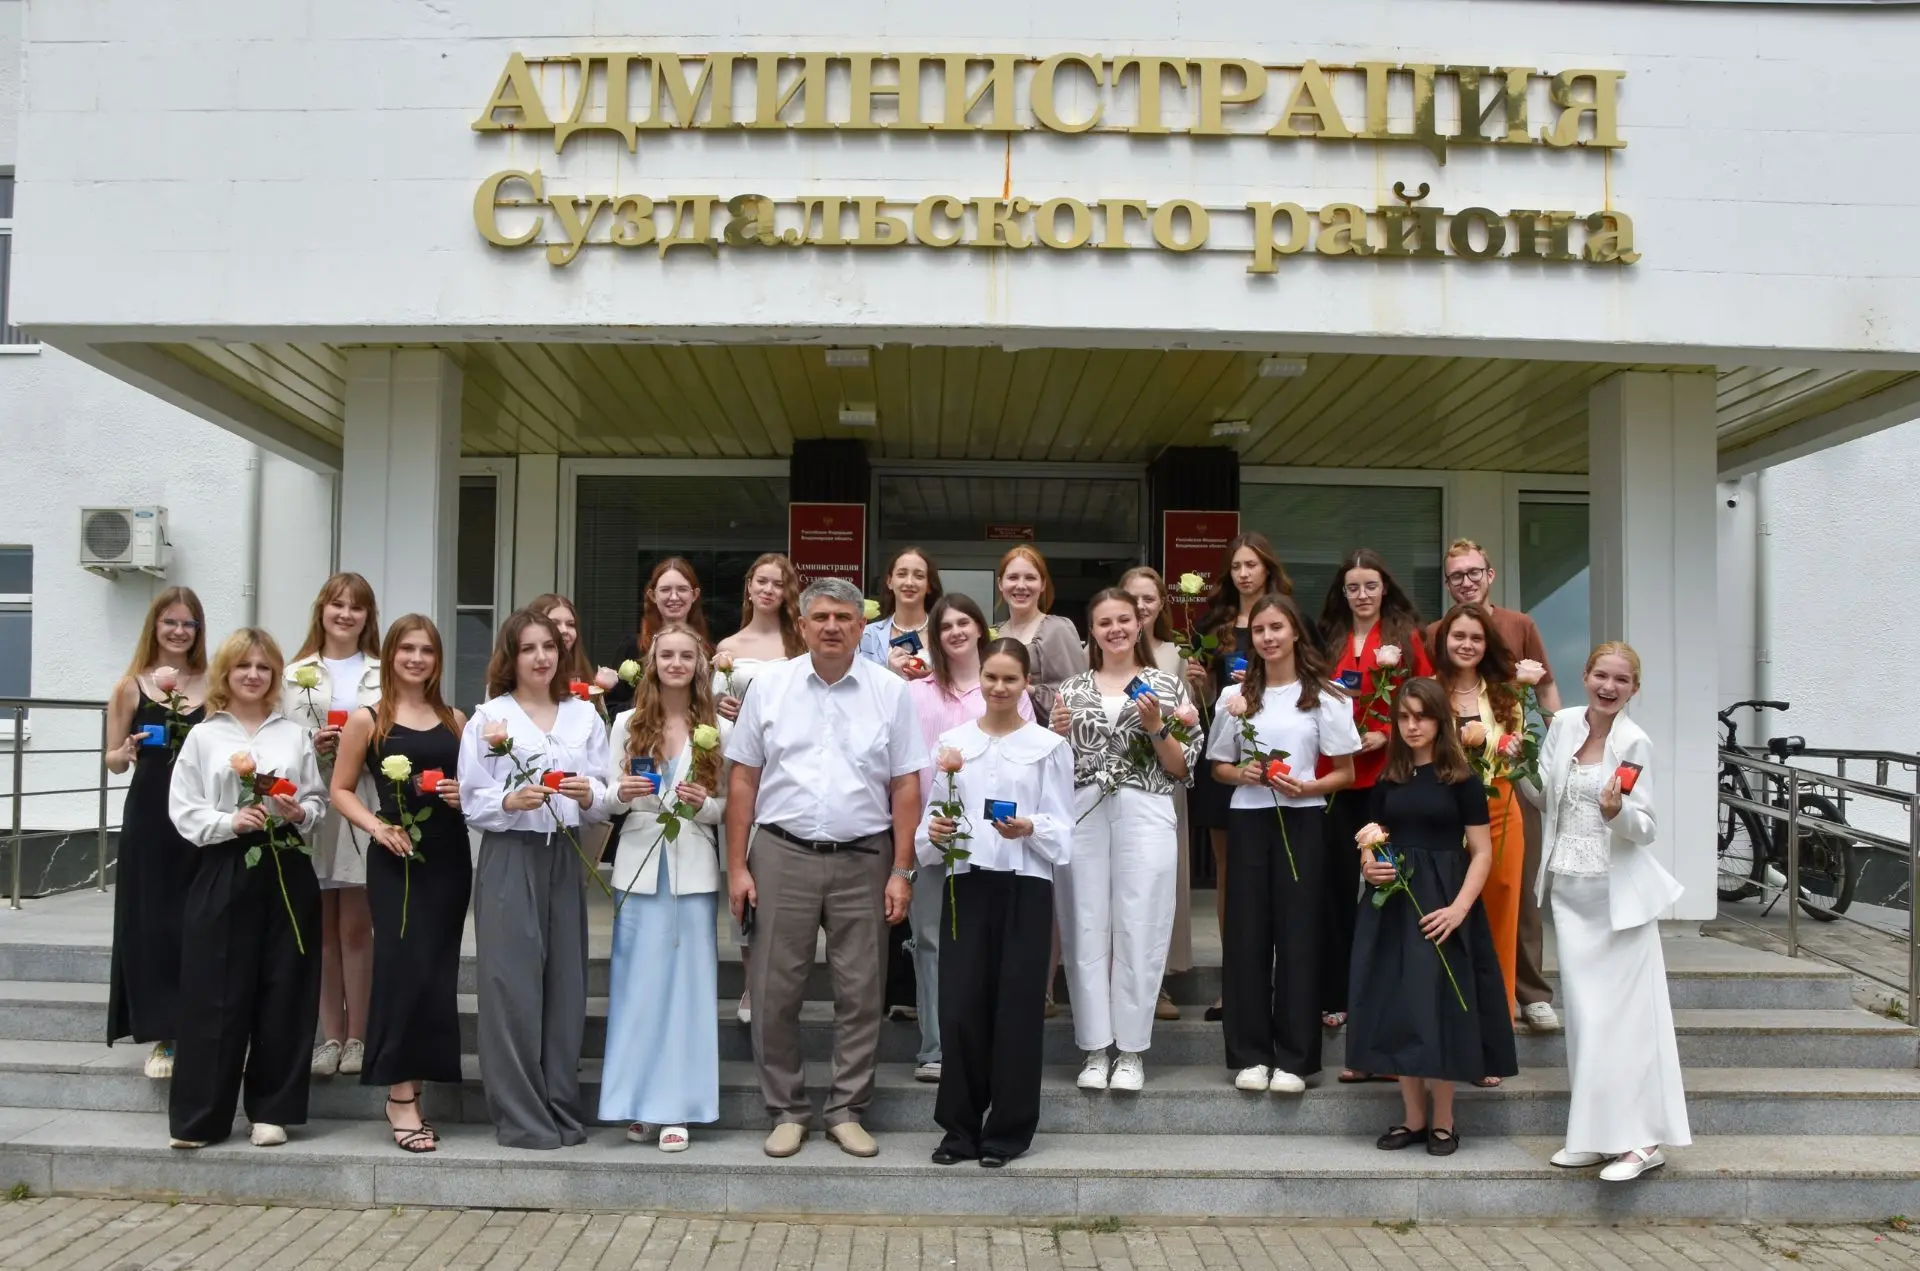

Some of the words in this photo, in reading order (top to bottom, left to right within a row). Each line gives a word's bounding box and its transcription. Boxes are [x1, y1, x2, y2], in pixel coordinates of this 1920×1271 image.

[471, 51, 1627, 166] АДМИНИСТРАЦИЯ
[473, 169, 1210, 266] Суздальского
[1246, 181, 1642, 274] района
[796, 562, 859, 572] Администрация
